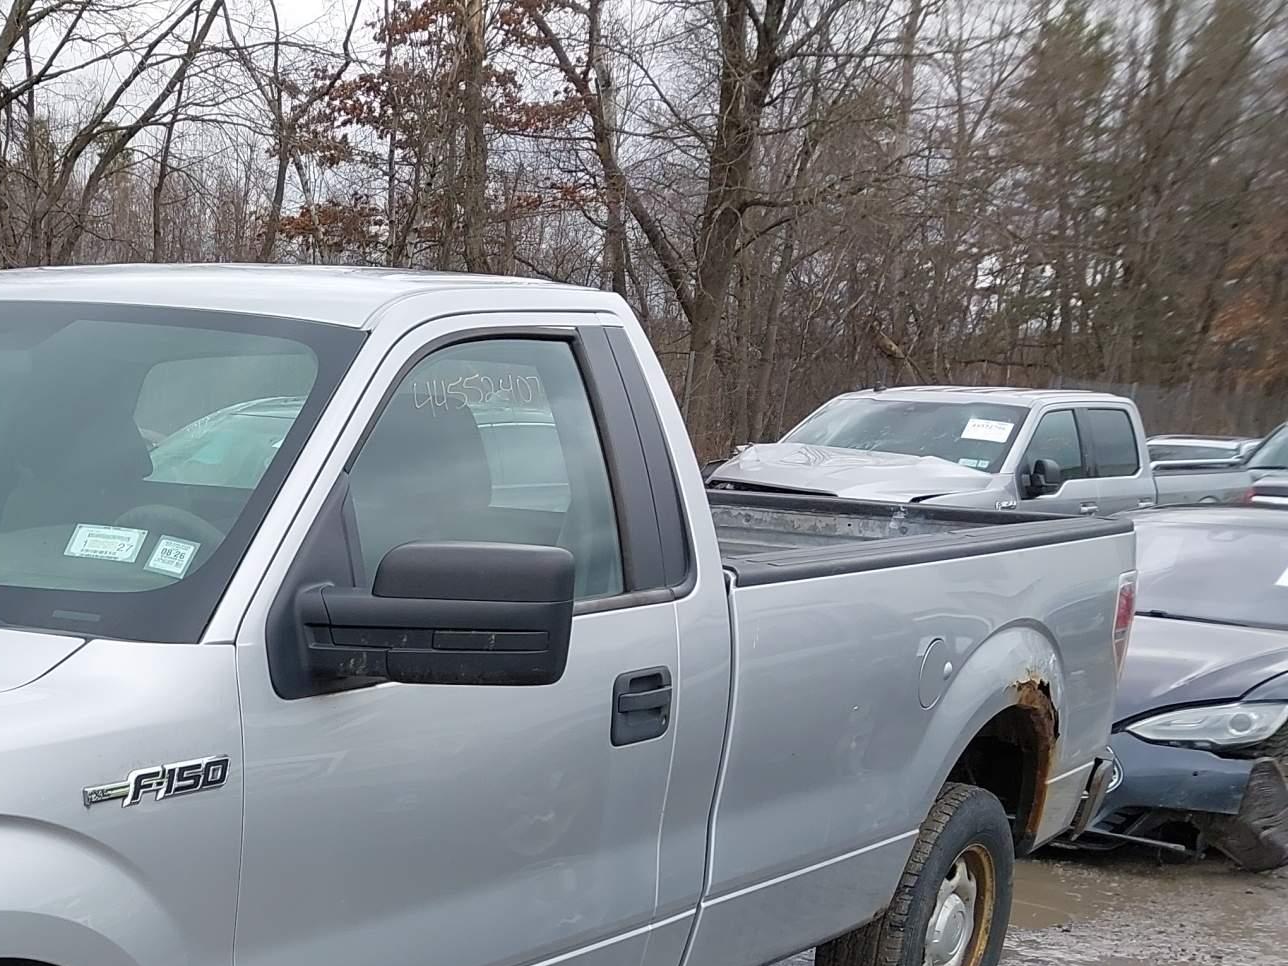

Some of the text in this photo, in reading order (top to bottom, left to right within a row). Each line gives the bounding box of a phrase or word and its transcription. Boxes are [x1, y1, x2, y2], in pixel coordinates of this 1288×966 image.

[412, 373, 541, 417] 44552407
[116, 542, 134, 553] 27
[123, 755, 231, 806] F-150
